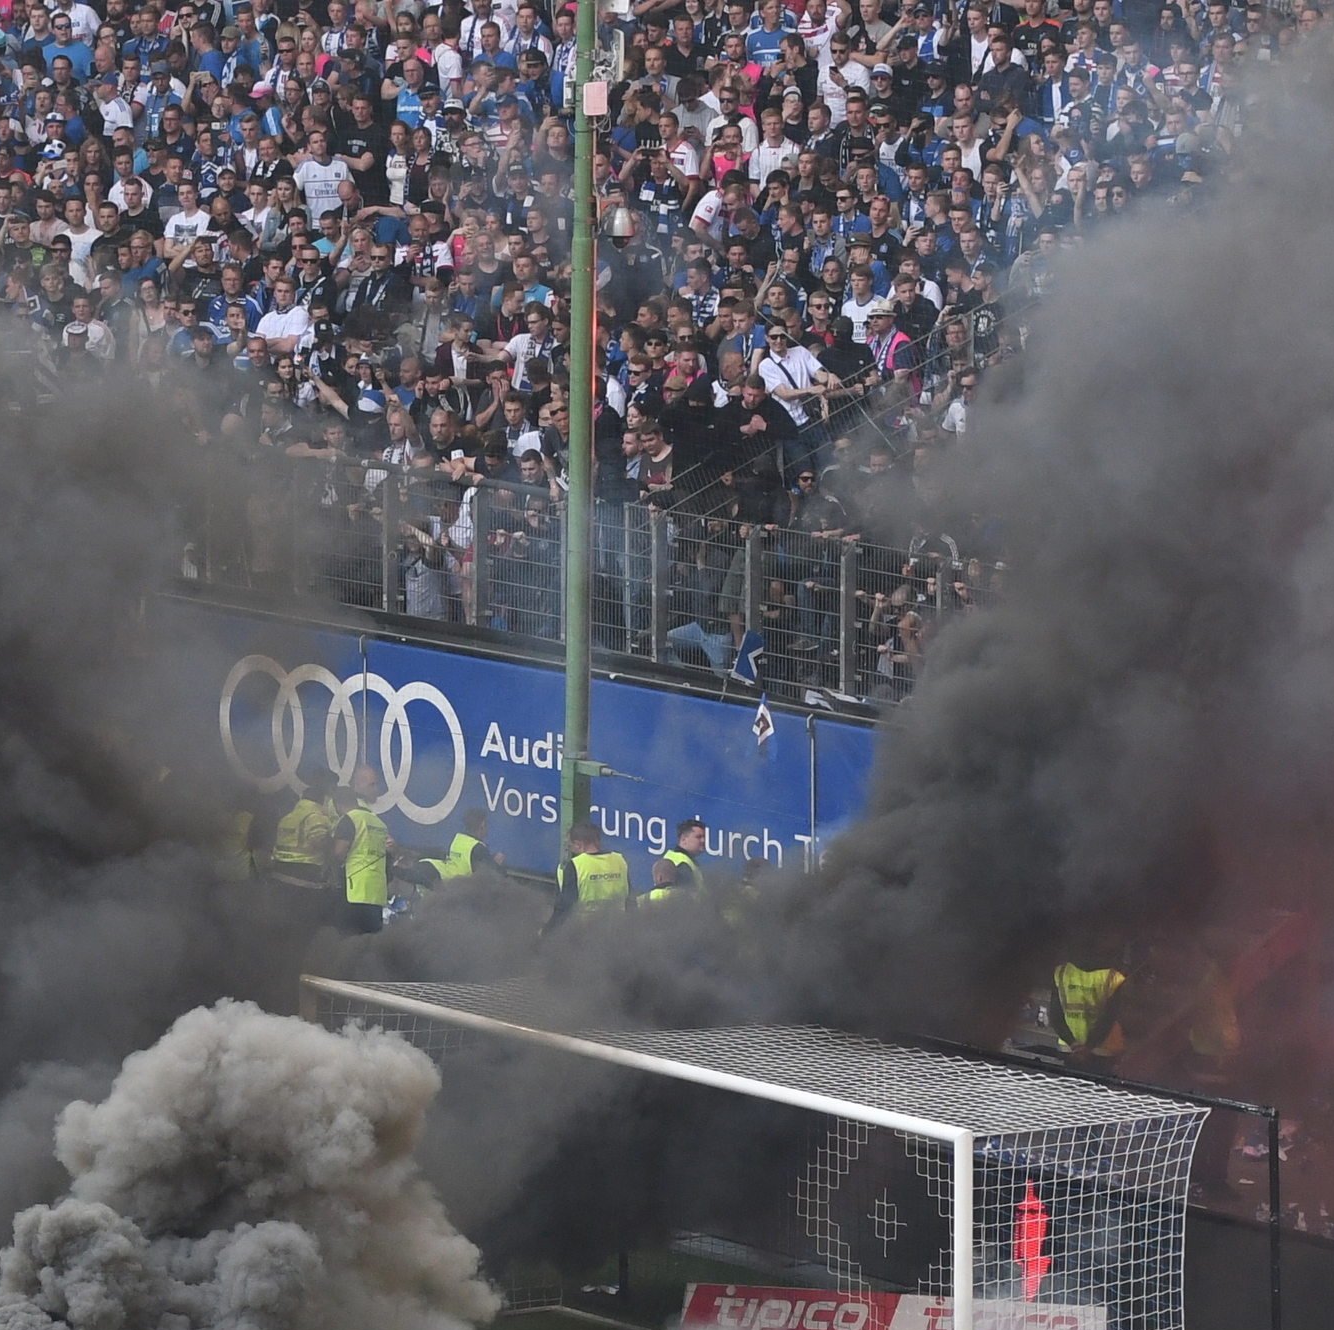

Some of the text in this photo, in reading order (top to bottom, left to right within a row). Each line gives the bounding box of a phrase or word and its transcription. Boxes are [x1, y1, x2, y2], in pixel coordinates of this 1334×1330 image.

[480, 721, 564, 771] Audi
[479, 773, 667, 855] Vorsrung
[679, 815, 783, 869] urch
